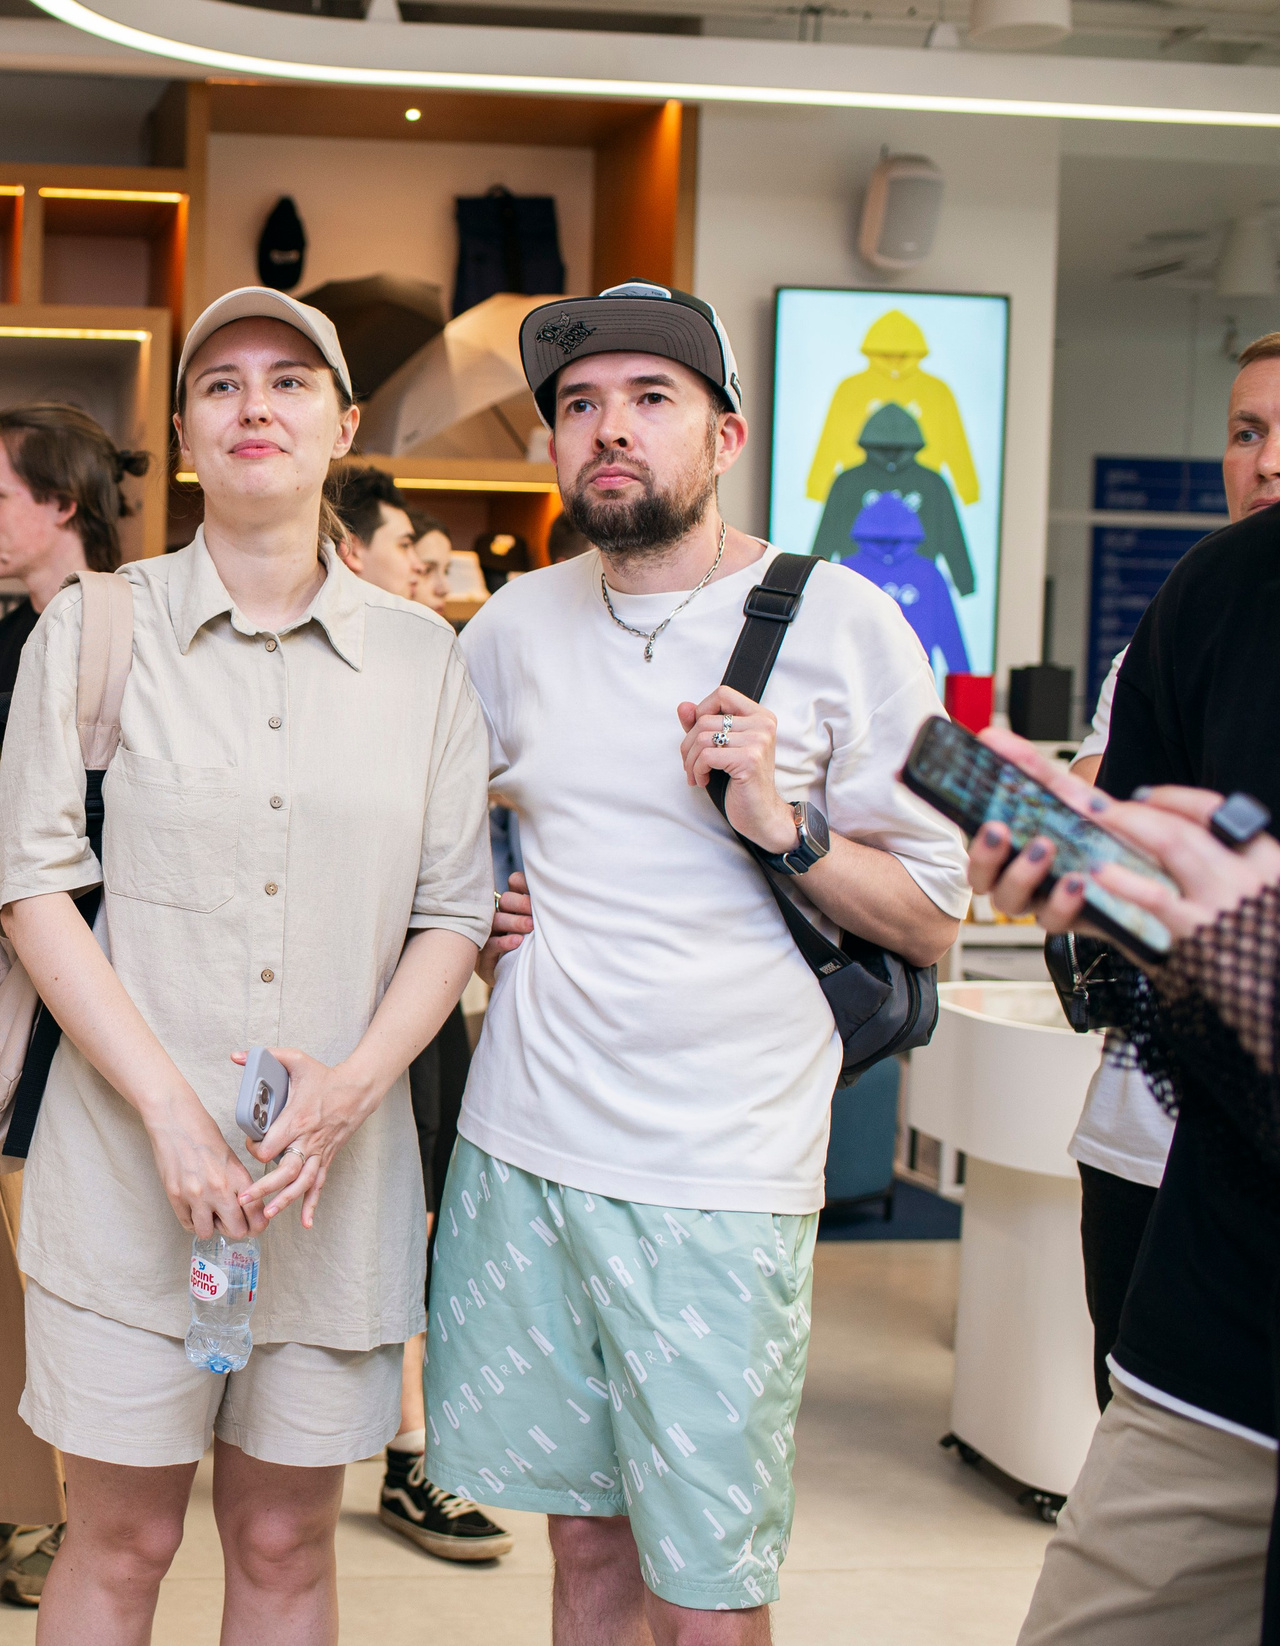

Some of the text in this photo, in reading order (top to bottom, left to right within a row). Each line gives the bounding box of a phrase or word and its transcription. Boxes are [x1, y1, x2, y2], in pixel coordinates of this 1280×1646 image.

[557, 320, 594, 354] JERRY
[190, 1274, 218, 1296] spring
[192, 1266, 215, 1284] saint
